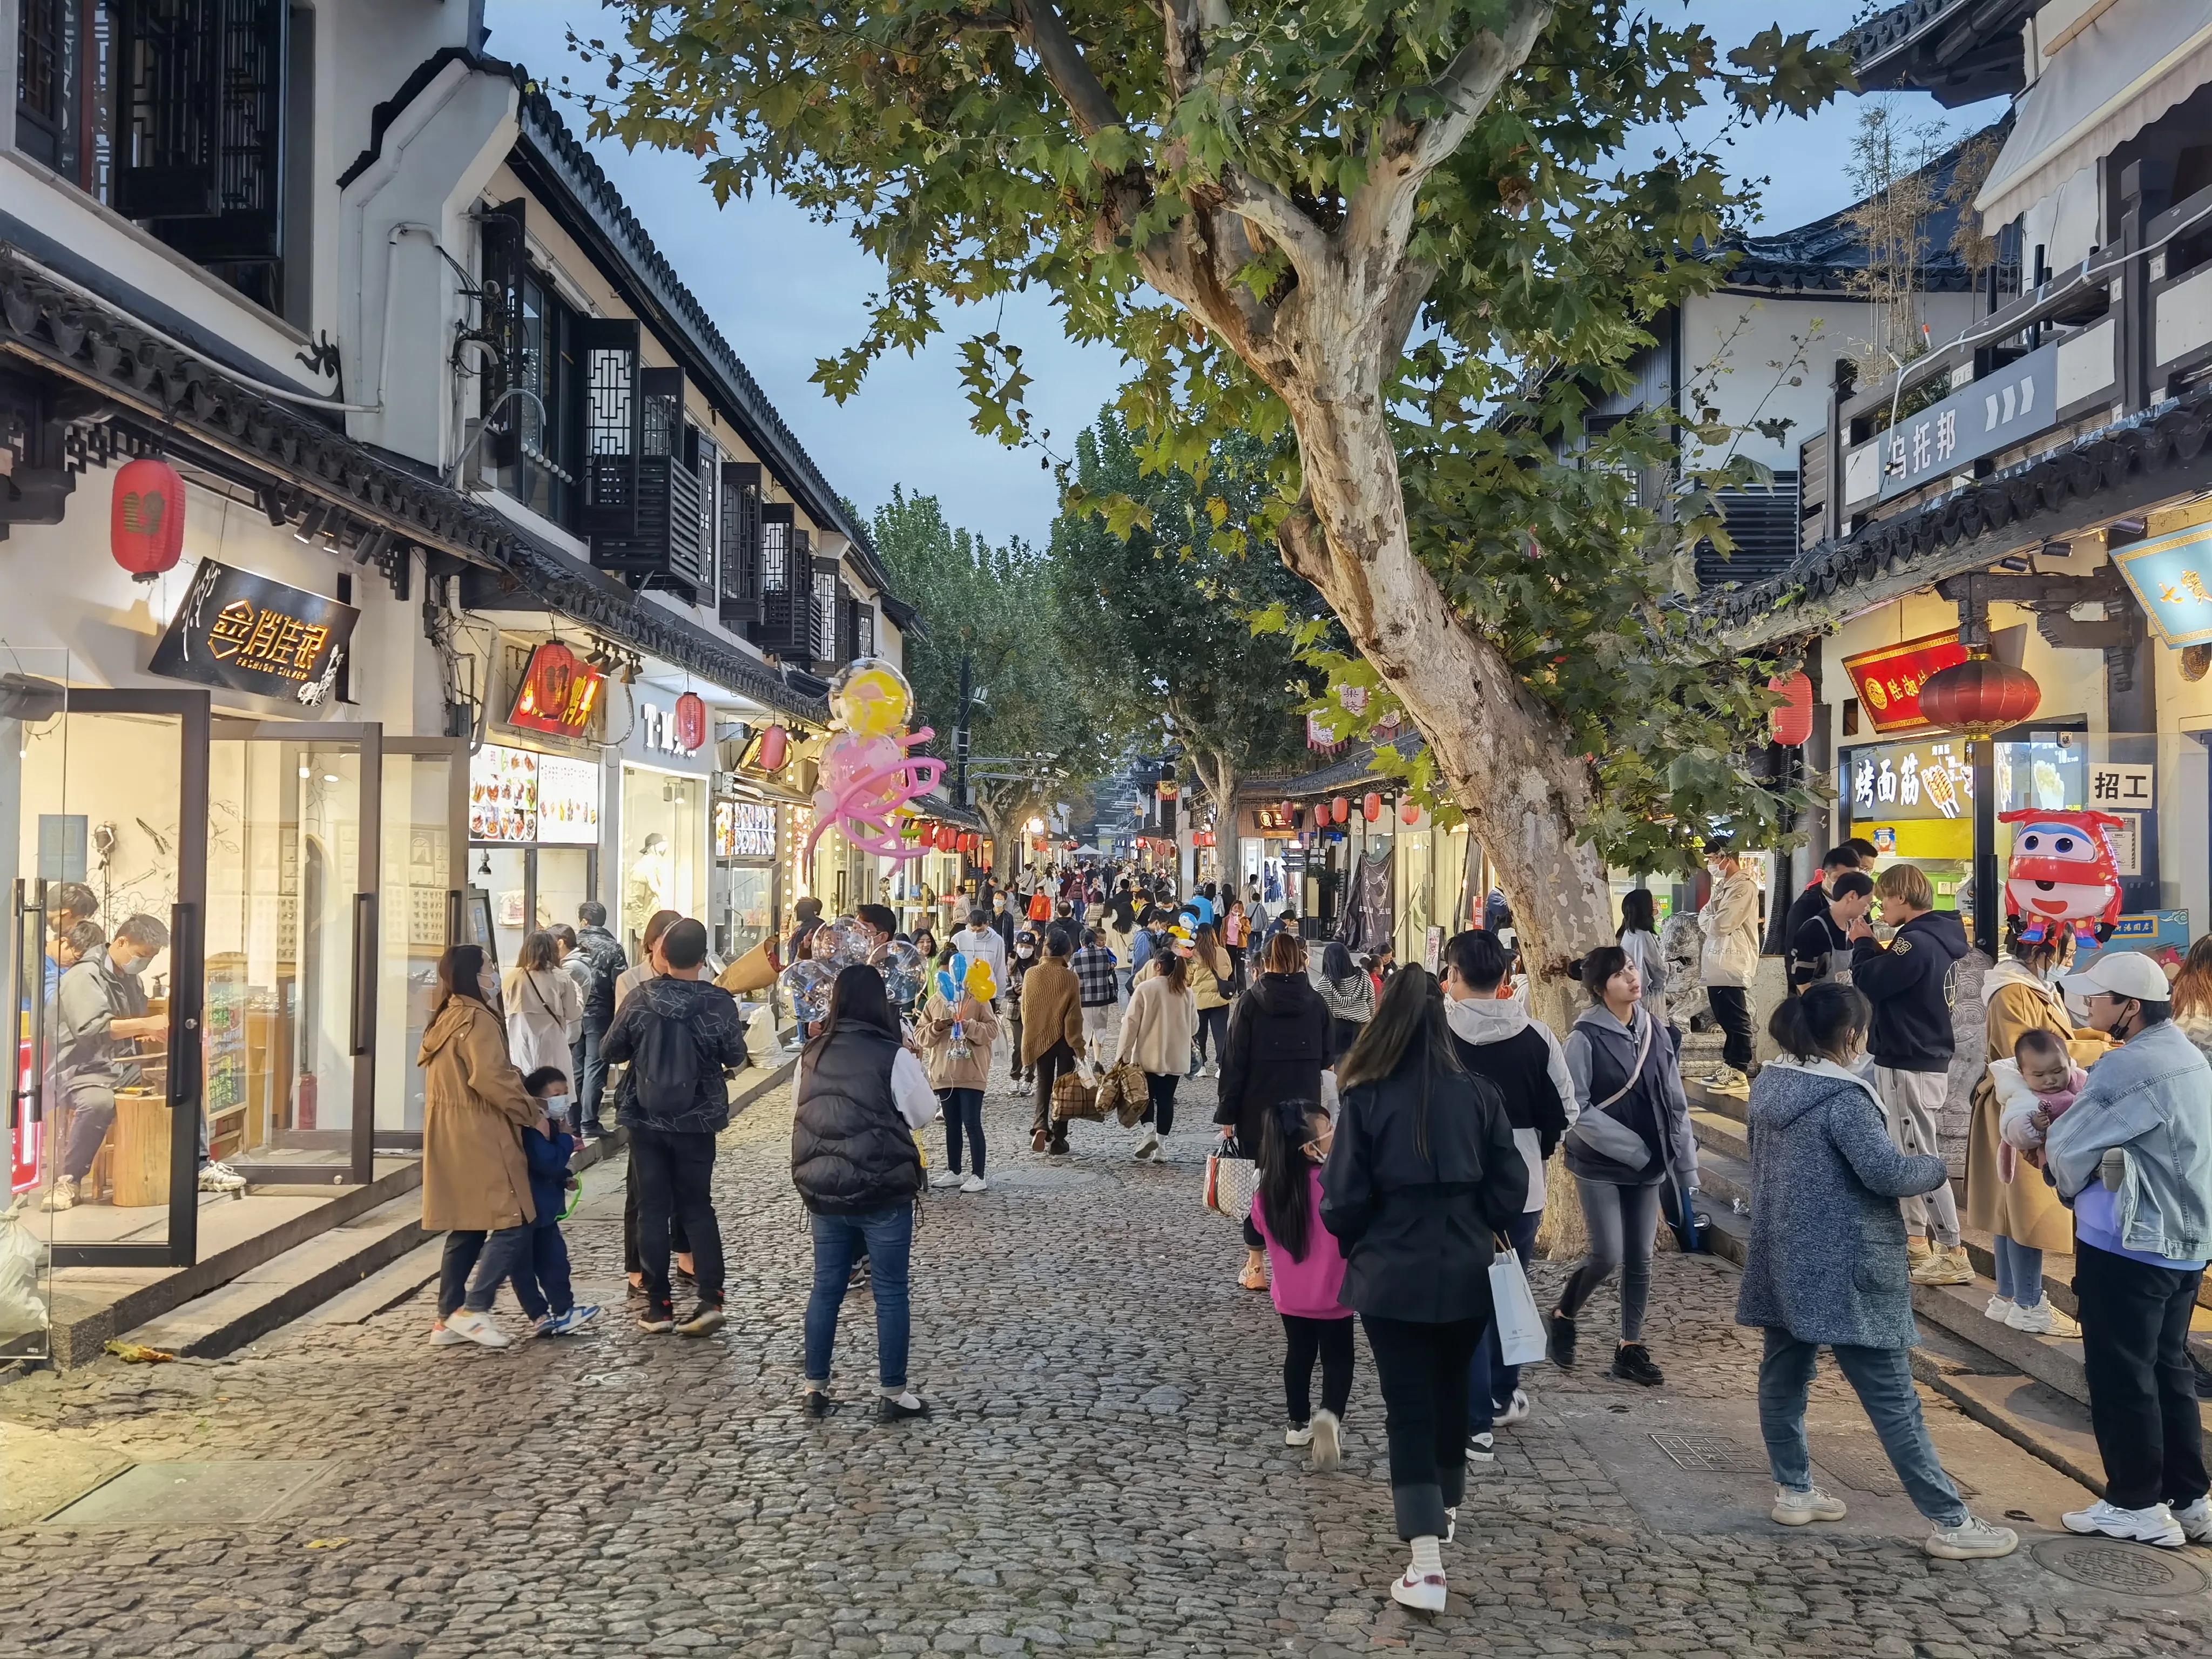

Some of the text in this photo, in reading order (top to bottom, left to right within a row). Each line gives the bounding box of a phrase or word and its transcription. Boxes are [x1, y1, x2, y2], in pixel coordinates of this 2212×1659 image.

[1891, 409, 1956, 480] 乌托邦
[235, 657, 309, 680] FASHION SILVER
[1855, 752, 1919, 809] 烤面筋
[2095, 772, 2148, 800] 招工
